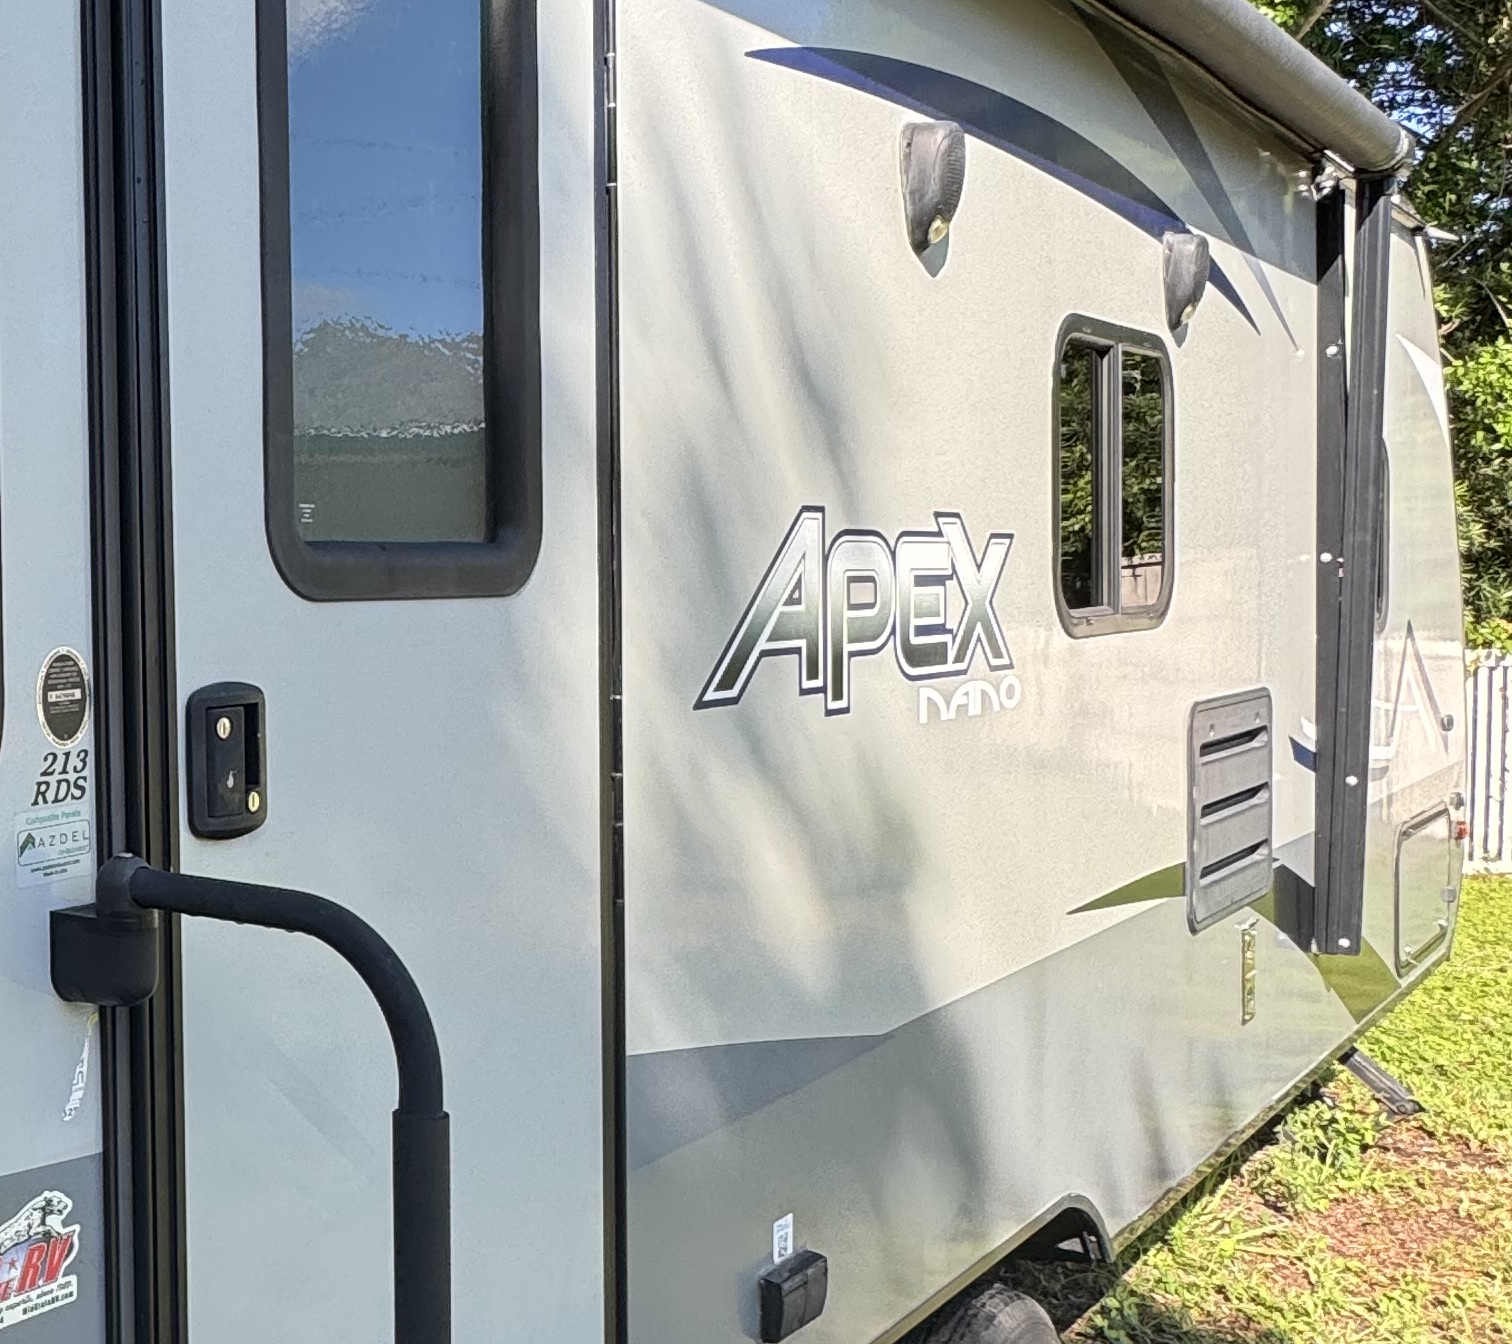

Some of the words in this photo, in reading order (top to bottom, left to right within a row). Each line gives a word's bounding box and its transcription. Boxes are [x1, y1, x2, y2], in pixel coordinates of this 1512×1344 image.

[693, 505, 1015, 717] APEX
[39, 749, 89, 777] 213
[31, 776, 88, 806] RDS
[37, 829, 89, 849] AZDEL
[14, 1229, 76, 1295] RV
